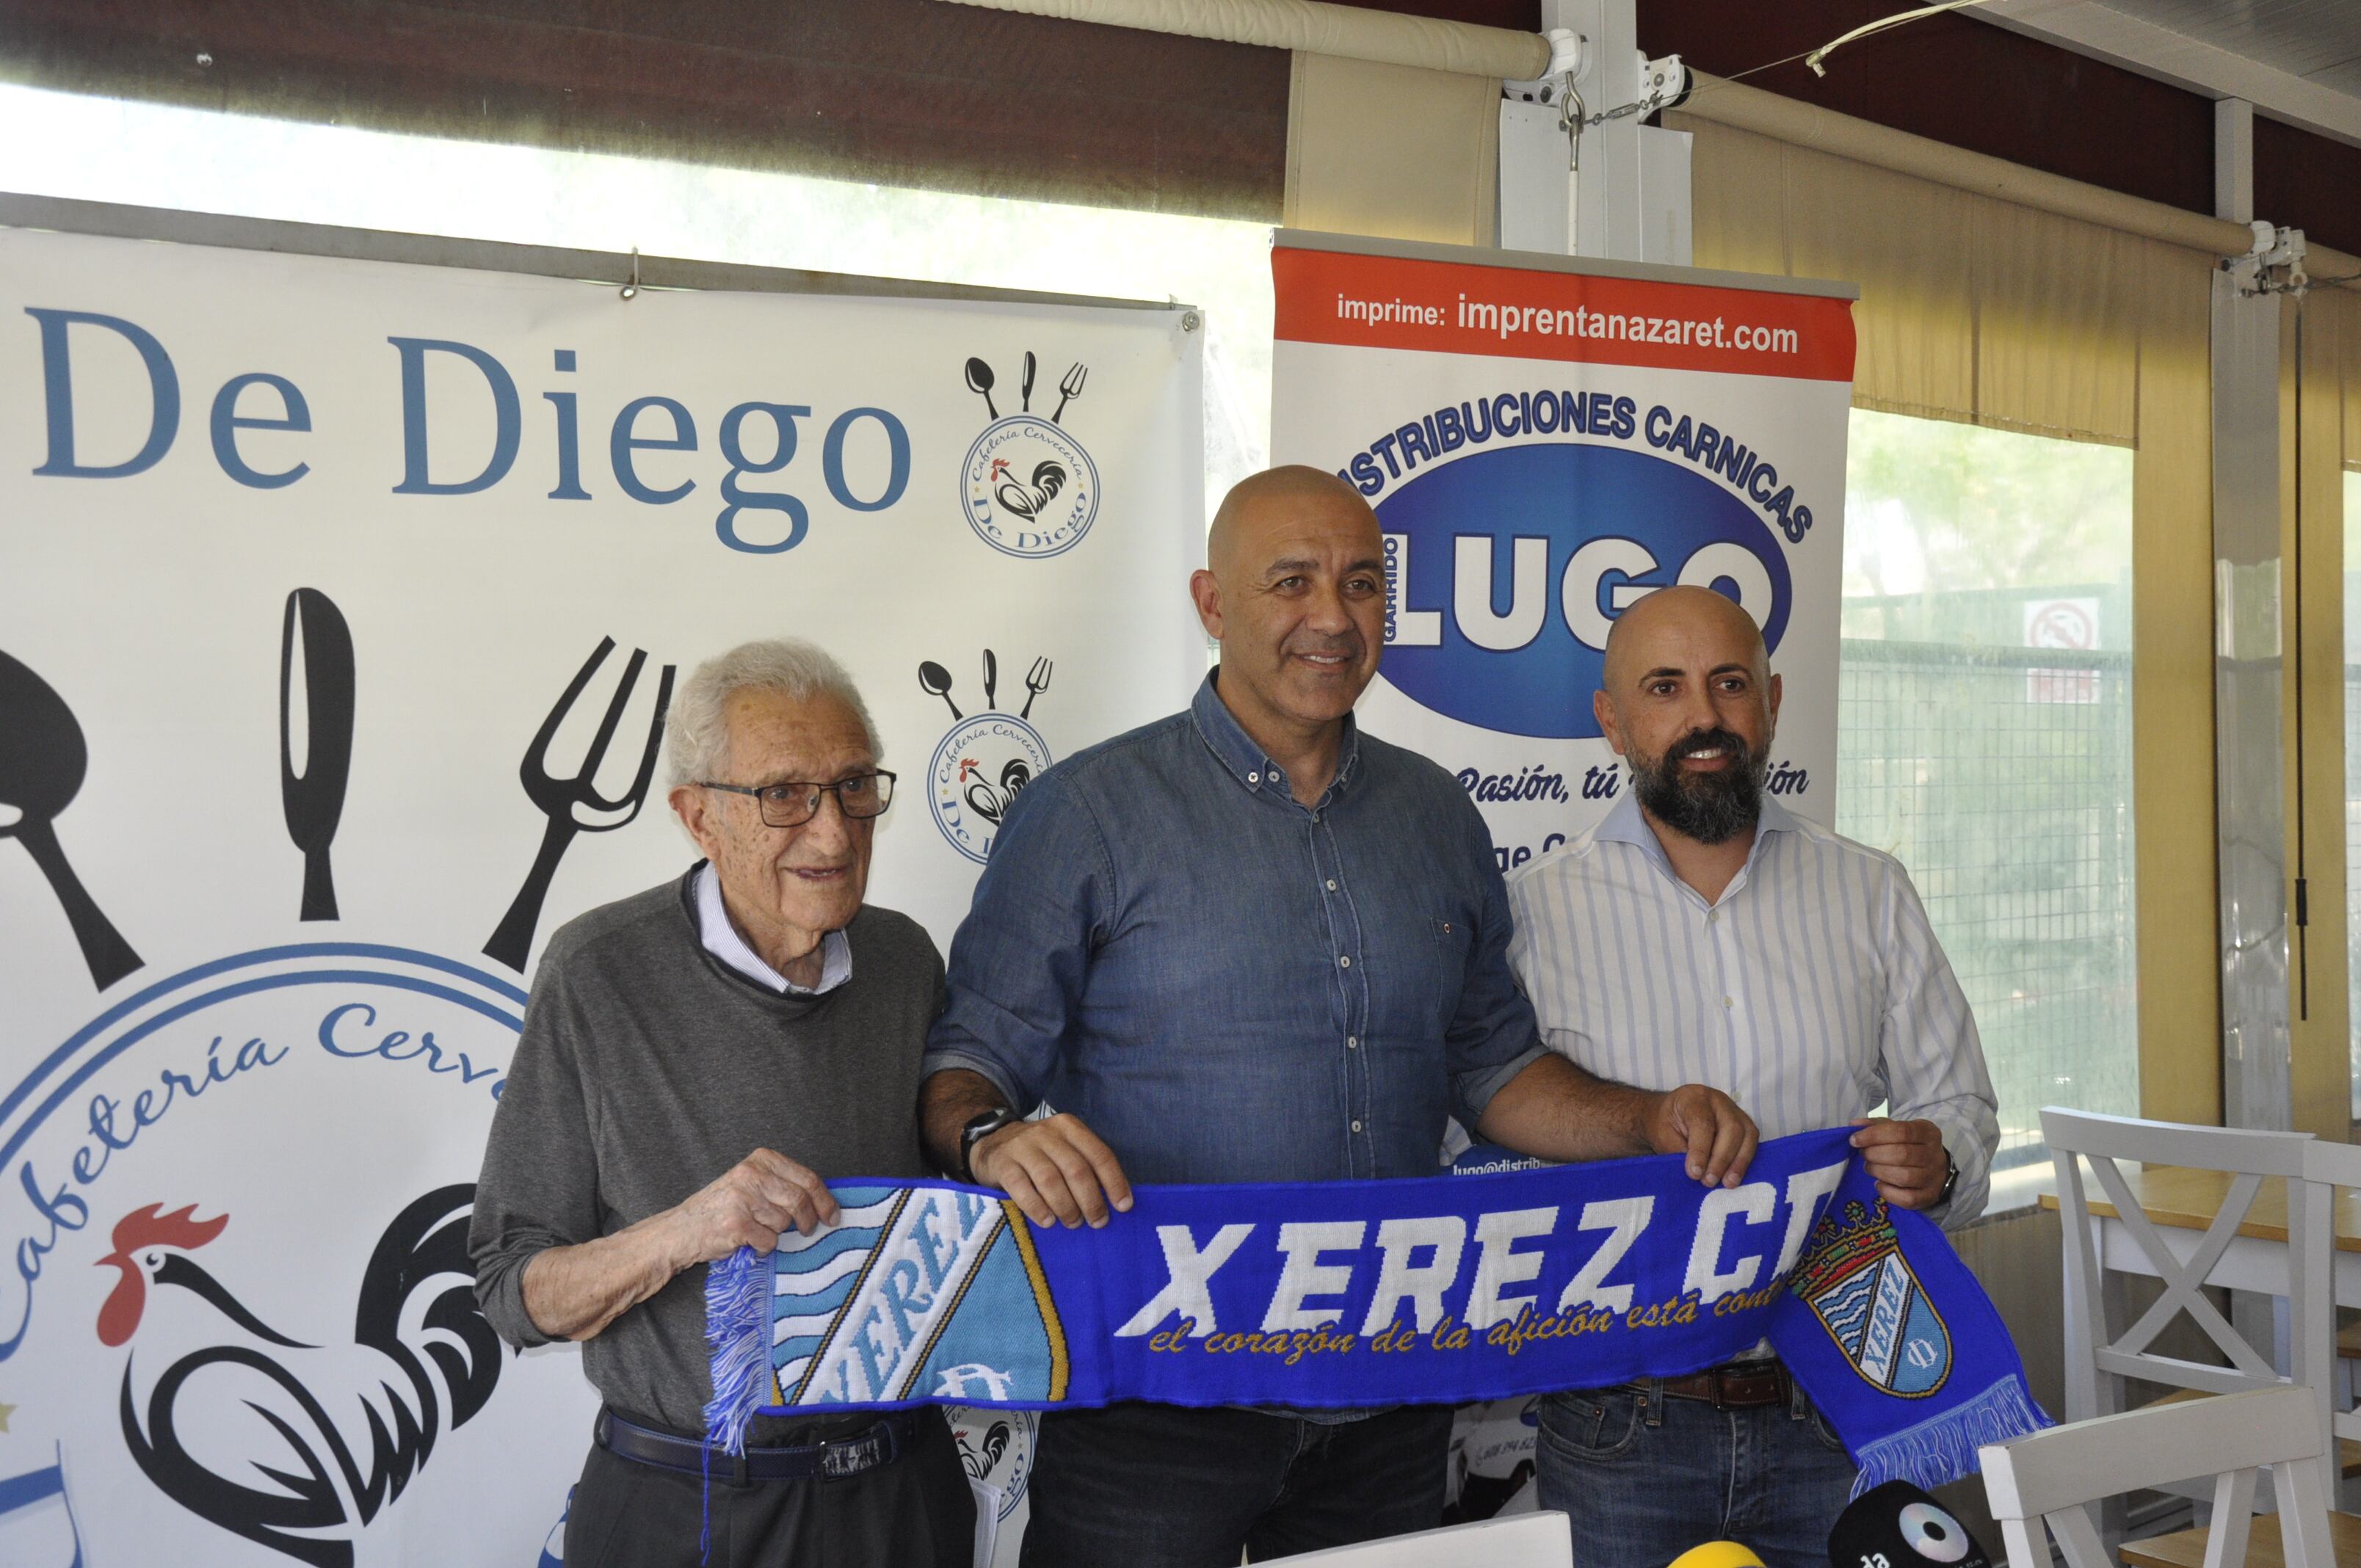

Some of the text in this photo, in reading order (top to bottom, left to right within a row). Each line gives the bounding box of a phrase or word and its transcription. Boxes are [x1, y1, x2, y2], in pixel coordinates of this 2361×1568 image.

[1338, 294, 1798, 353] imprime: imprentanazaret.com
[24, 307, 910, 553] De Diego
[1644, 405, 1813, 544] CARNICAS
[973, 493, 1086, 548] De Diego
[1384, 537, 1398, 642] GARRIDO
[941, 796, 970, 843] De
[1582, 763, 1620, 799] tú
[0, 1036, 289, 1362] afetería
[1114, 1196, 1655, 1337] XEREZ
[1865, 1261, 1904, 1375] XEREZ
[1149, 1321, 1192, 1352] el
[1204, 1324, 1357, 1366] corazón
[1371, 1320, 1416, 1354] de
[1431, 1316, 1469, 1350] la
[1487, 1304, 1613, 1356] afición
[1626, 1292, 1699, 1328] está
